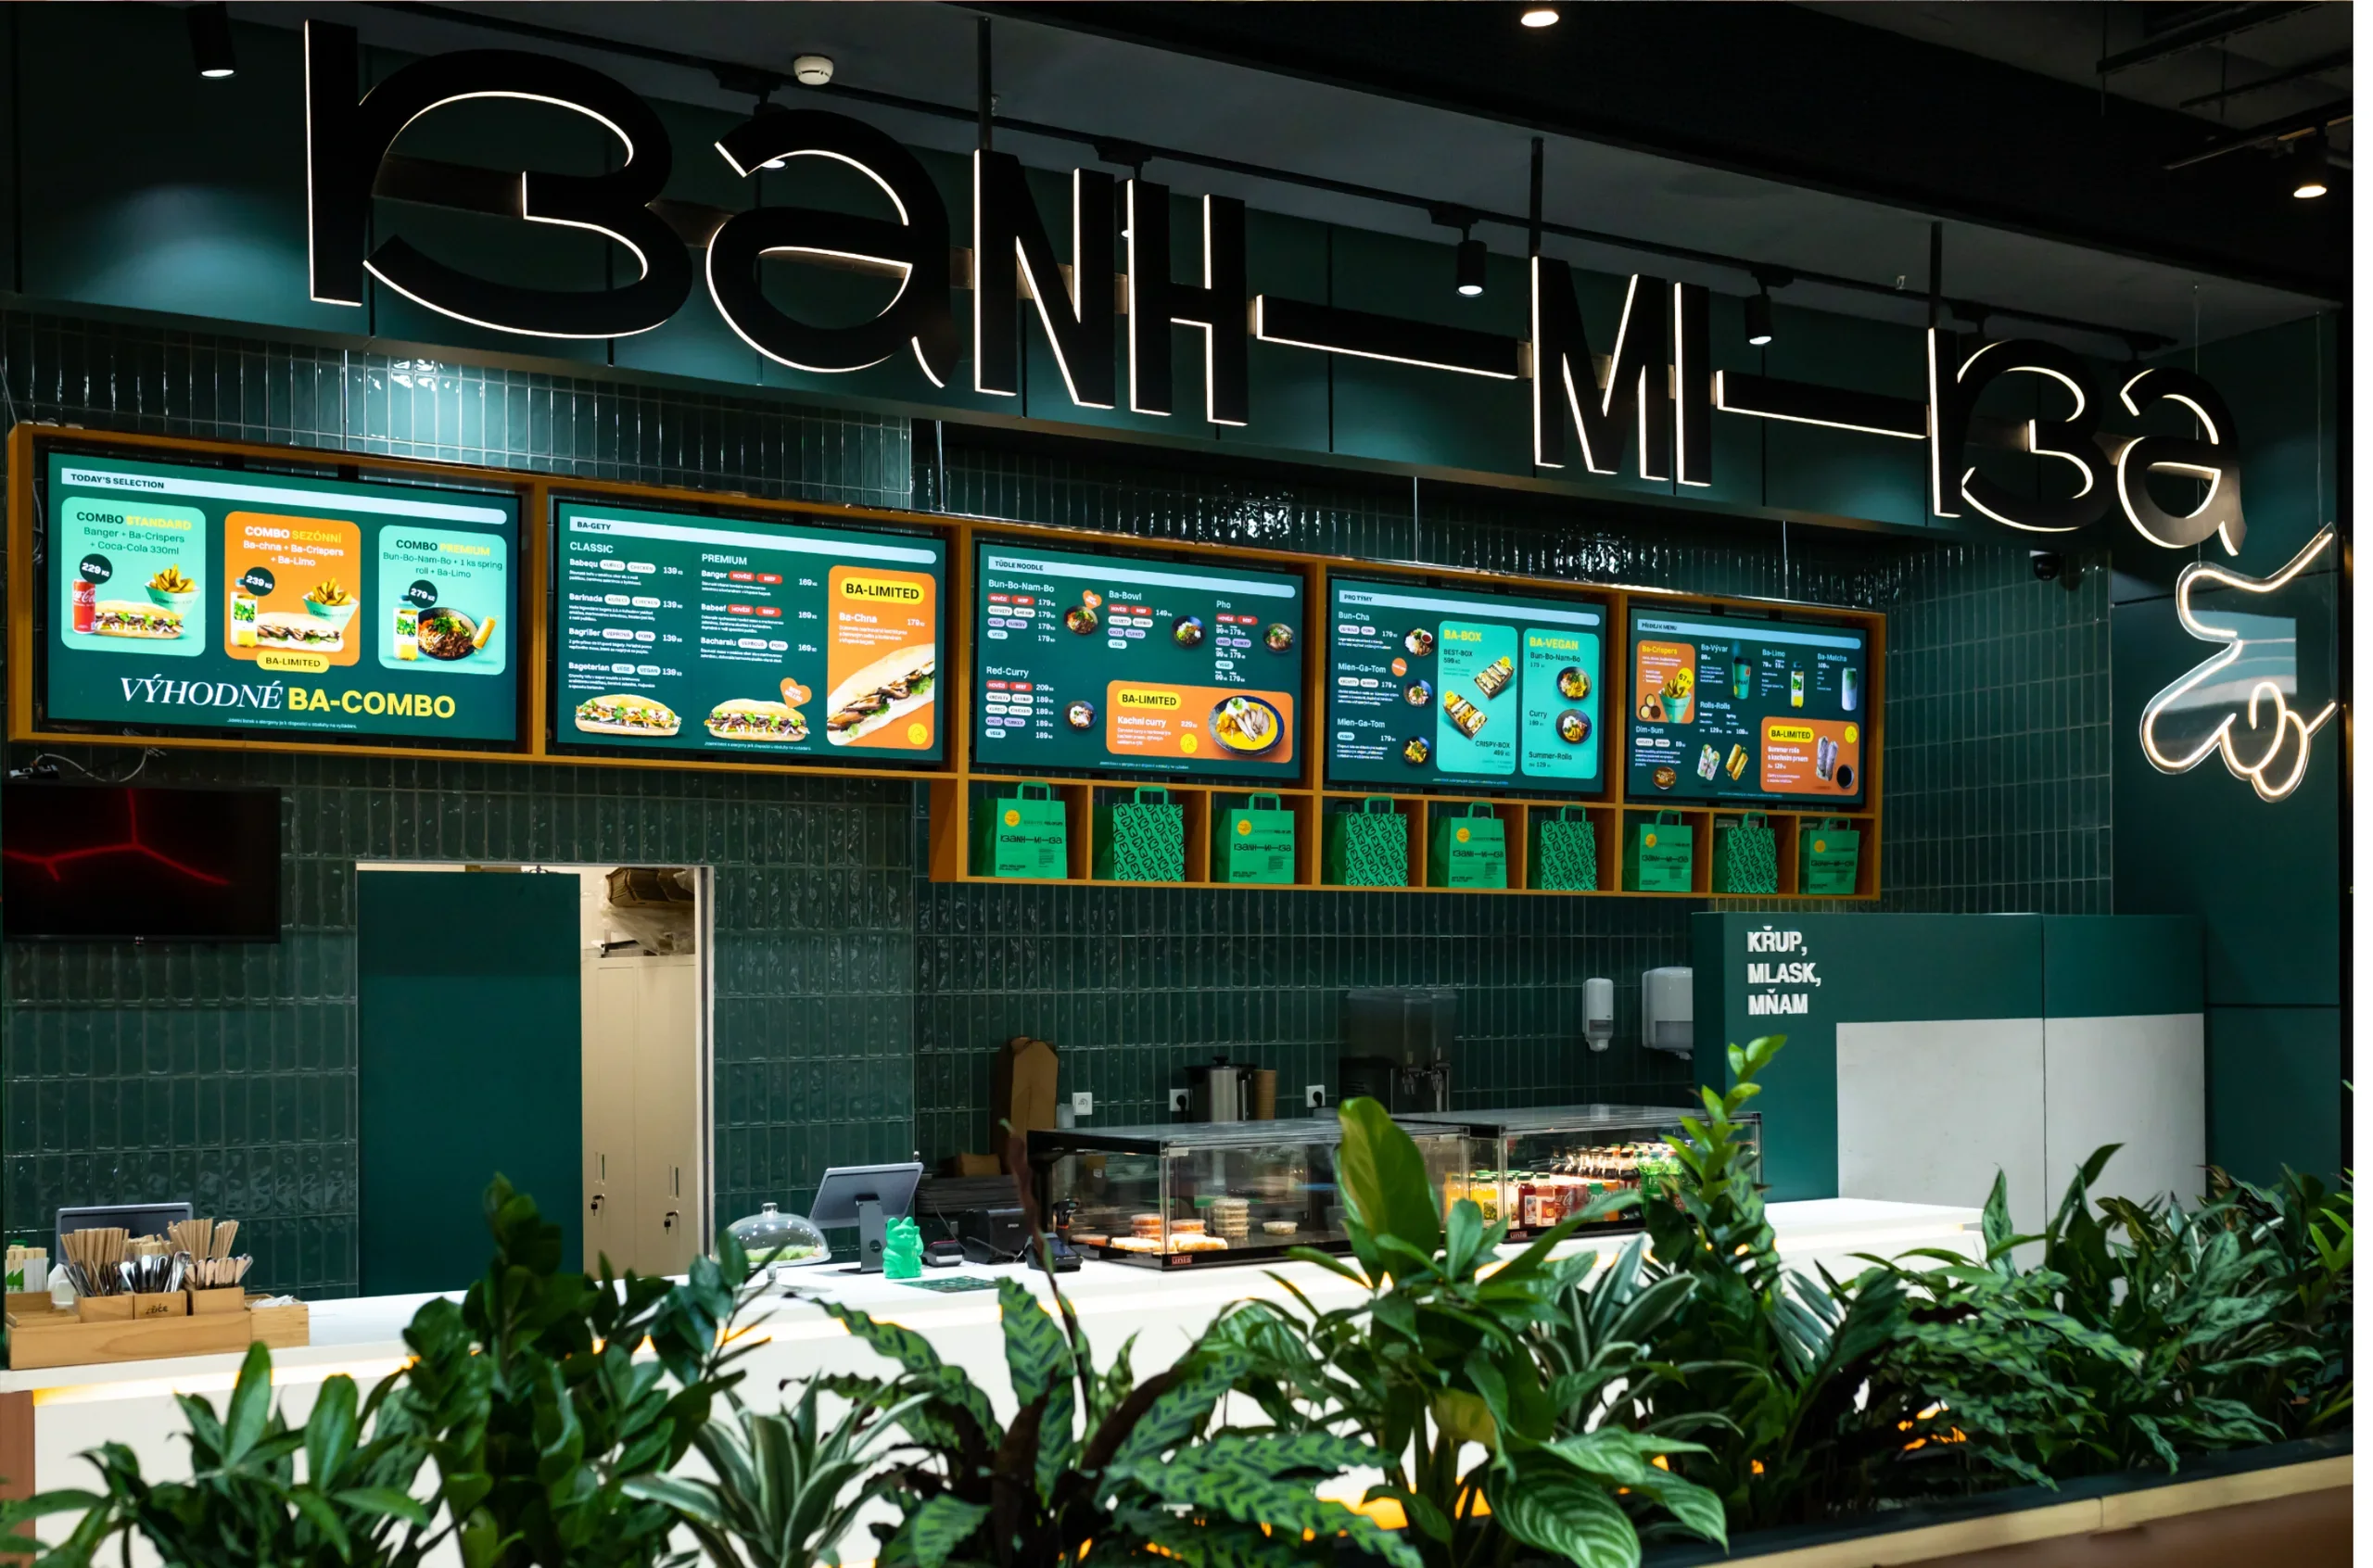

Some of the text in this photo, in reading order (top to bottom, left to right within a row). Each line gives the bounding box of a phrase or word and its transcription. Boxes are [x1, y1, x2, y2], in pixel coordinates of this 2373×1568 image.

[71, 474, 165, 488] TODAY'S SELECTION
[76, 512, 192, 530] COMBO STANDARD
[577, 521, 611, 531] BA-GETY
[83, 527, 119, 538] Banger
[129, 530, 184, 543] Ba-Crispers
[245, 525, 342, 543] COMBO SEZÓNNÍ
[97, 541, 148, 553] Coca-Cola
[150, 545, 179, 555] 330ml
[291, 544, 344, 556] Ba-Crispers
[396, 539, 490, 556] COMBO PREMIUM
[570, 541, 614, 553] CLASSIC
[278, 555, 316, 566] Ba-Limo
[383, 552, 451, 564] Bun-Bo-Nam-Bo
[466, 559, 476, 567] ks
[477, 561, 503, 571] spring
[702, 553, 747, 565] PREMIUM
[82, 563, 102, 575] 229
[415, 566, 429, 575] roll
[438, 568, 471, 578] Ba-Limo
[569, 559, 598, 569] Babequ
[663, 566, 678, 575] 139
[1017, 563, 1044, 571] NOODLE
[246, 575, 264, 587] 239
[701, 570, 728, 580] Banger
[846, 583, 920, 600] BA-LIMITED
[988, 579, 1055, 593] Bun-Bo-Nam-Bo
[410, 588, 427, 600] 279
[569, 593, 603, 602] Barinada
[1109, 590, 1142, 601] Ba-Bowl
[701, 603, 727, 612] Babeef
[1216, 600, 1231, 609] Pho
[839, 612, 878, 623] Ba-Chna
[1339, 611, 1370, 621] Bun-Cha
[568, 627, 601, 638] Bagriller
[663, 634, 677, 642] 139
[1443, 629, 1482, 642] BA-BOX
[1529, 637, 1579, 650] BA-VEGAN
[1443, 649, 1473, 657] BEST-BOX
[1530, 651, 1580, 663] Bun-Bo-Nam-Bo
[1762, 649, 1785, 657] Ba-Limo
[1818, 653, 1847, 662] Ba-Matcha
[265, 656, 321, 668] BA-LIMITED
[568, 662, 610, 672] Bageterian
[986, 666, 1029, 678] Red-Curry
[1338, 663, 1386, 674] Mien-Ga-Tom
[1679, 673, 1687, 682] 67
[120, 673, 456, 719] VÝHODNÉ BA-COMBO
[1122, 694, 1177, 706] BA-LIMITED
[1700, 702, 1731, 710] Rolls-Rolls
[1529, 710, 1547, 719] Curry
[1145, 719, 1166, 728] curry
[1337, 717, 1386, 728] Mien-Ga-Tom
[1635, 726, 1664, 734] Dim-Sum
[1771, 729, 1811, 740] BA-LIMITED
[1475, 740, 1511, 749] CRISPY-BOX
[1529, 751, 1572, 761] Summer-Rolls
[1746, 925, 1808, 956] KŘUP,
[1747, 962, 1821, 987] MLASK,
[1747, 988, 1808, 1015] MŇAM
